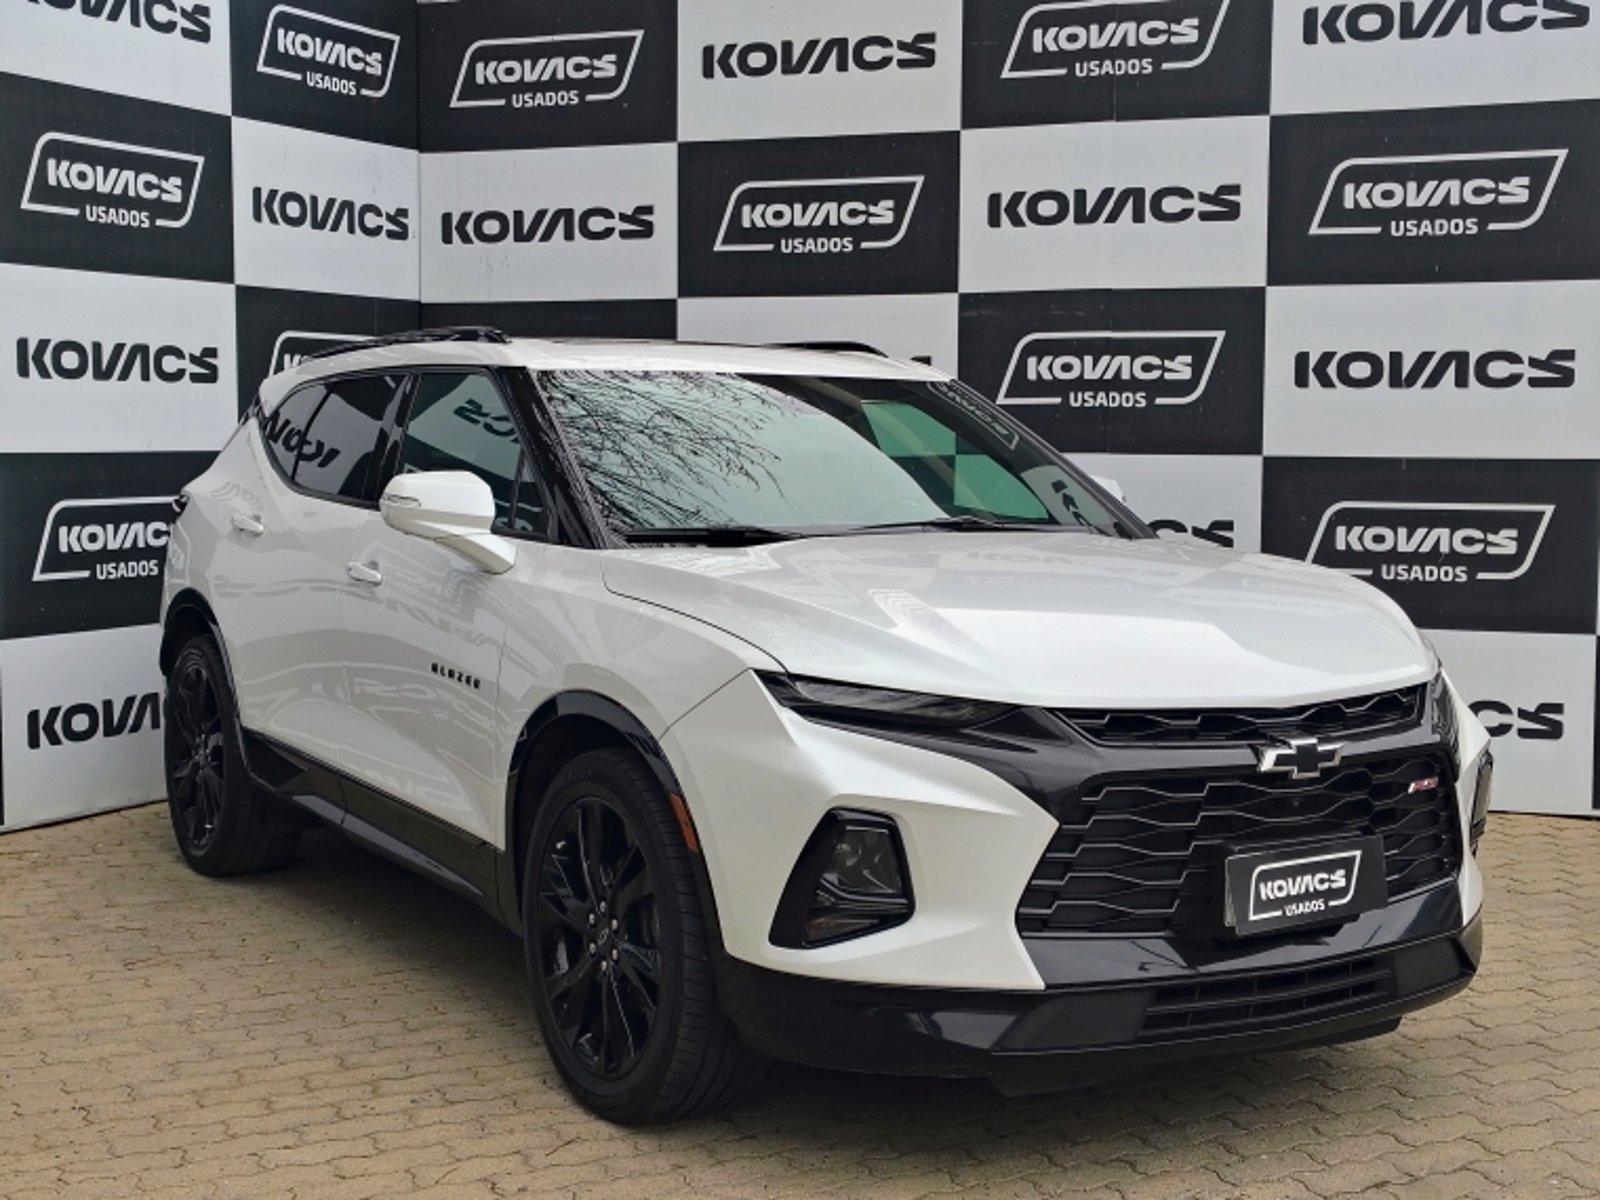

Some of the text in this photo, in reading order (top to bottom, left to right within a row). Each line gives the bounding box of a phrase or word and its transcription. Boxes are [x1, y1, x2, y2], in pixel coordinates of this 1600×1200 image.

[1032, 16, 1199, 54] KOVACS
[1302, 0, 1590, 46] KOVACS
[277, 26, 383, 77] KOVACS
[702, 31, 937, 80] KOVACS
[1075, 58, 1153, 77] USADOS
[305, 70, 358, 97] USADOS
[475, 53, 617, 86] KOVACS
[512, 90, 580, 108] USADOS
[47, 157, 183, 205] KOVACS
[1343, 176, 1530, 209] KOVACS
[85, 204, 150, 228] USADOS
[252, 186, 409, 241] KOVACS
[741, 199, 895, 228] KOVACS
[987, 183, 1241, 229] KOVACS
[441, 204, 654, 245] KOVACS
[1390, 218, 1479, 237] USADOS
[780, 236, 854, 254] USADOS
[16, 337, 219, 384] KOVACS
[1026, 354, 1193, 381] KOVACS
[1294, 348, 1576, 389] KOVACS
[1069, 391, 1147, 408] USADOS
[58, 521, 169, 554] KOVAC
[1335, 525, 1519, 555] KOVACS
[96, 559, 159, 580] USADOS
[1381, 564, 1468, 582] USADOS
[27, 691, 161, 750] KOVA
[1258, 868, 1347, 902] KOVACS
